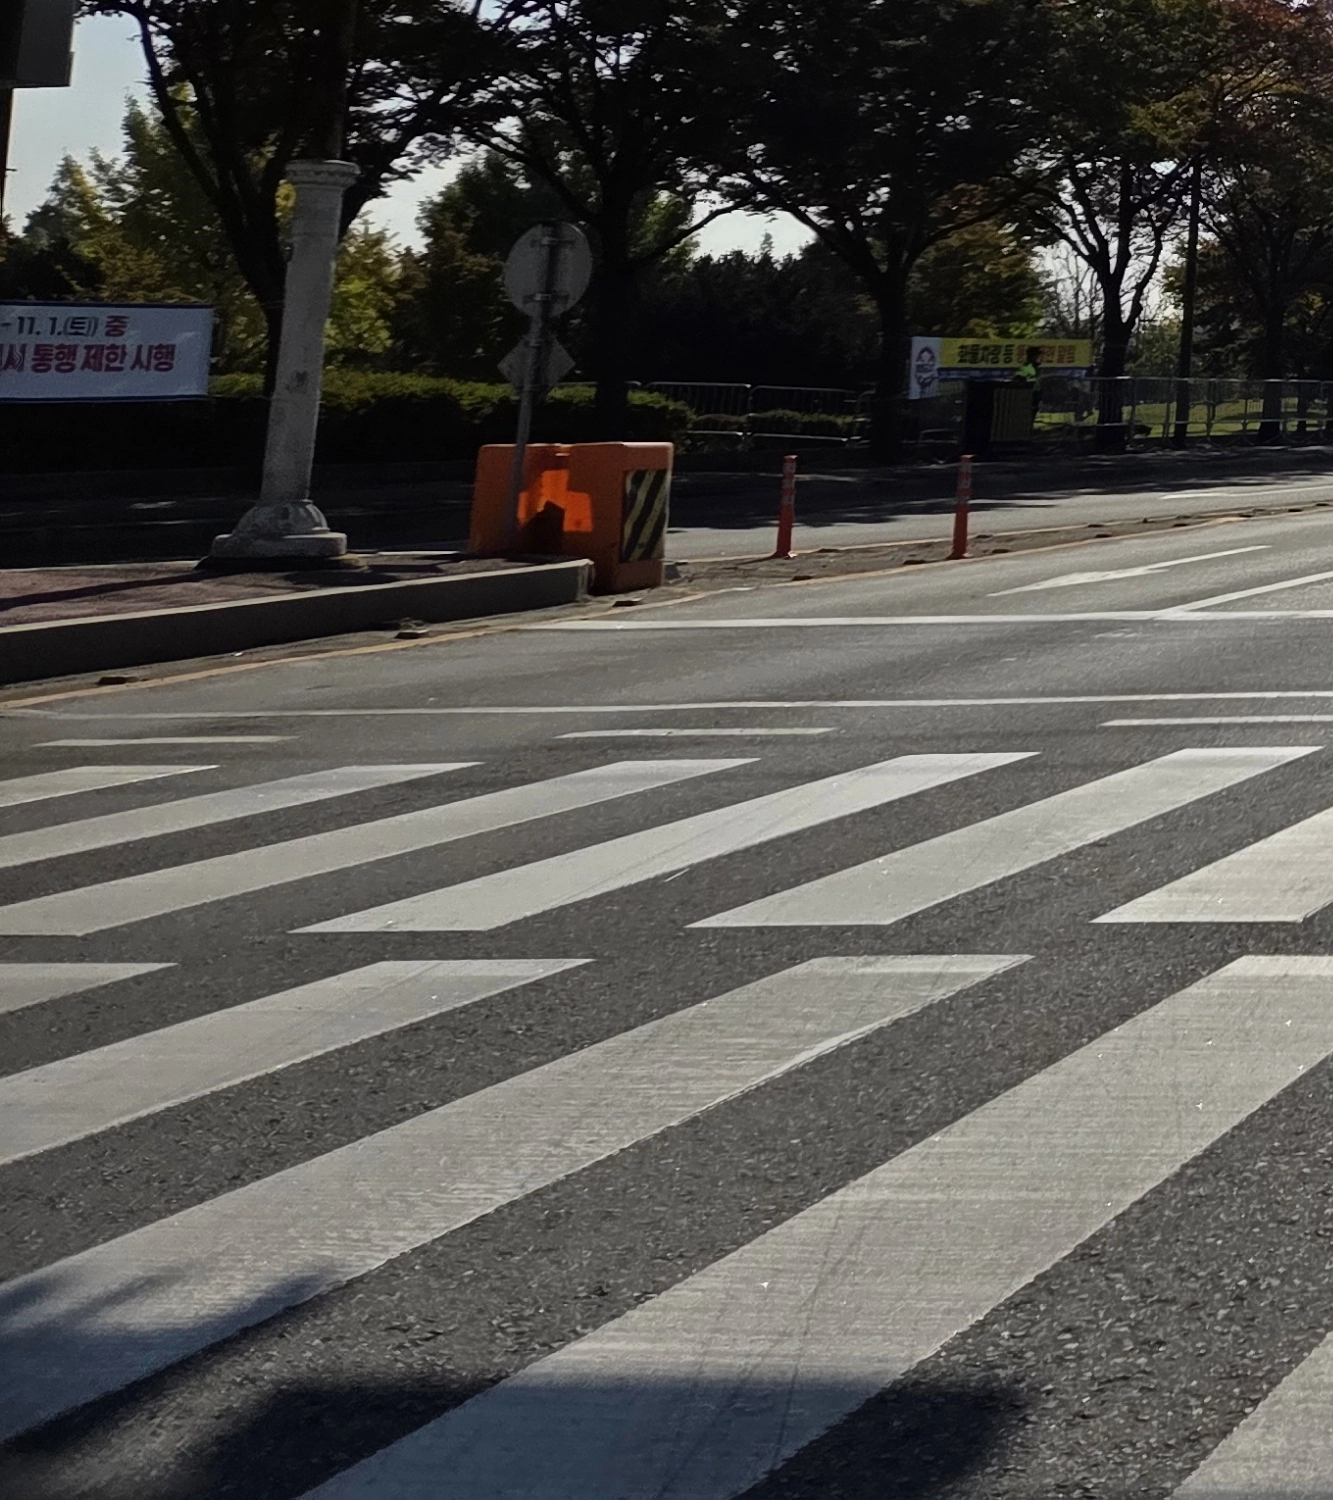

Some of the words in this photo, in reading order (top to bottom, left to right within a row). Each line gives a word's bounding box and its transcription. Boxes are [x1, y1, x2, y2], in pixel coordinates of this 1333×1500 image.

[105, 315, 130, 337] 중
[31, 343, 78, 373] 통행
[80, 343, 127, 373] 제한
[130, 343, 176, 373] 시행
